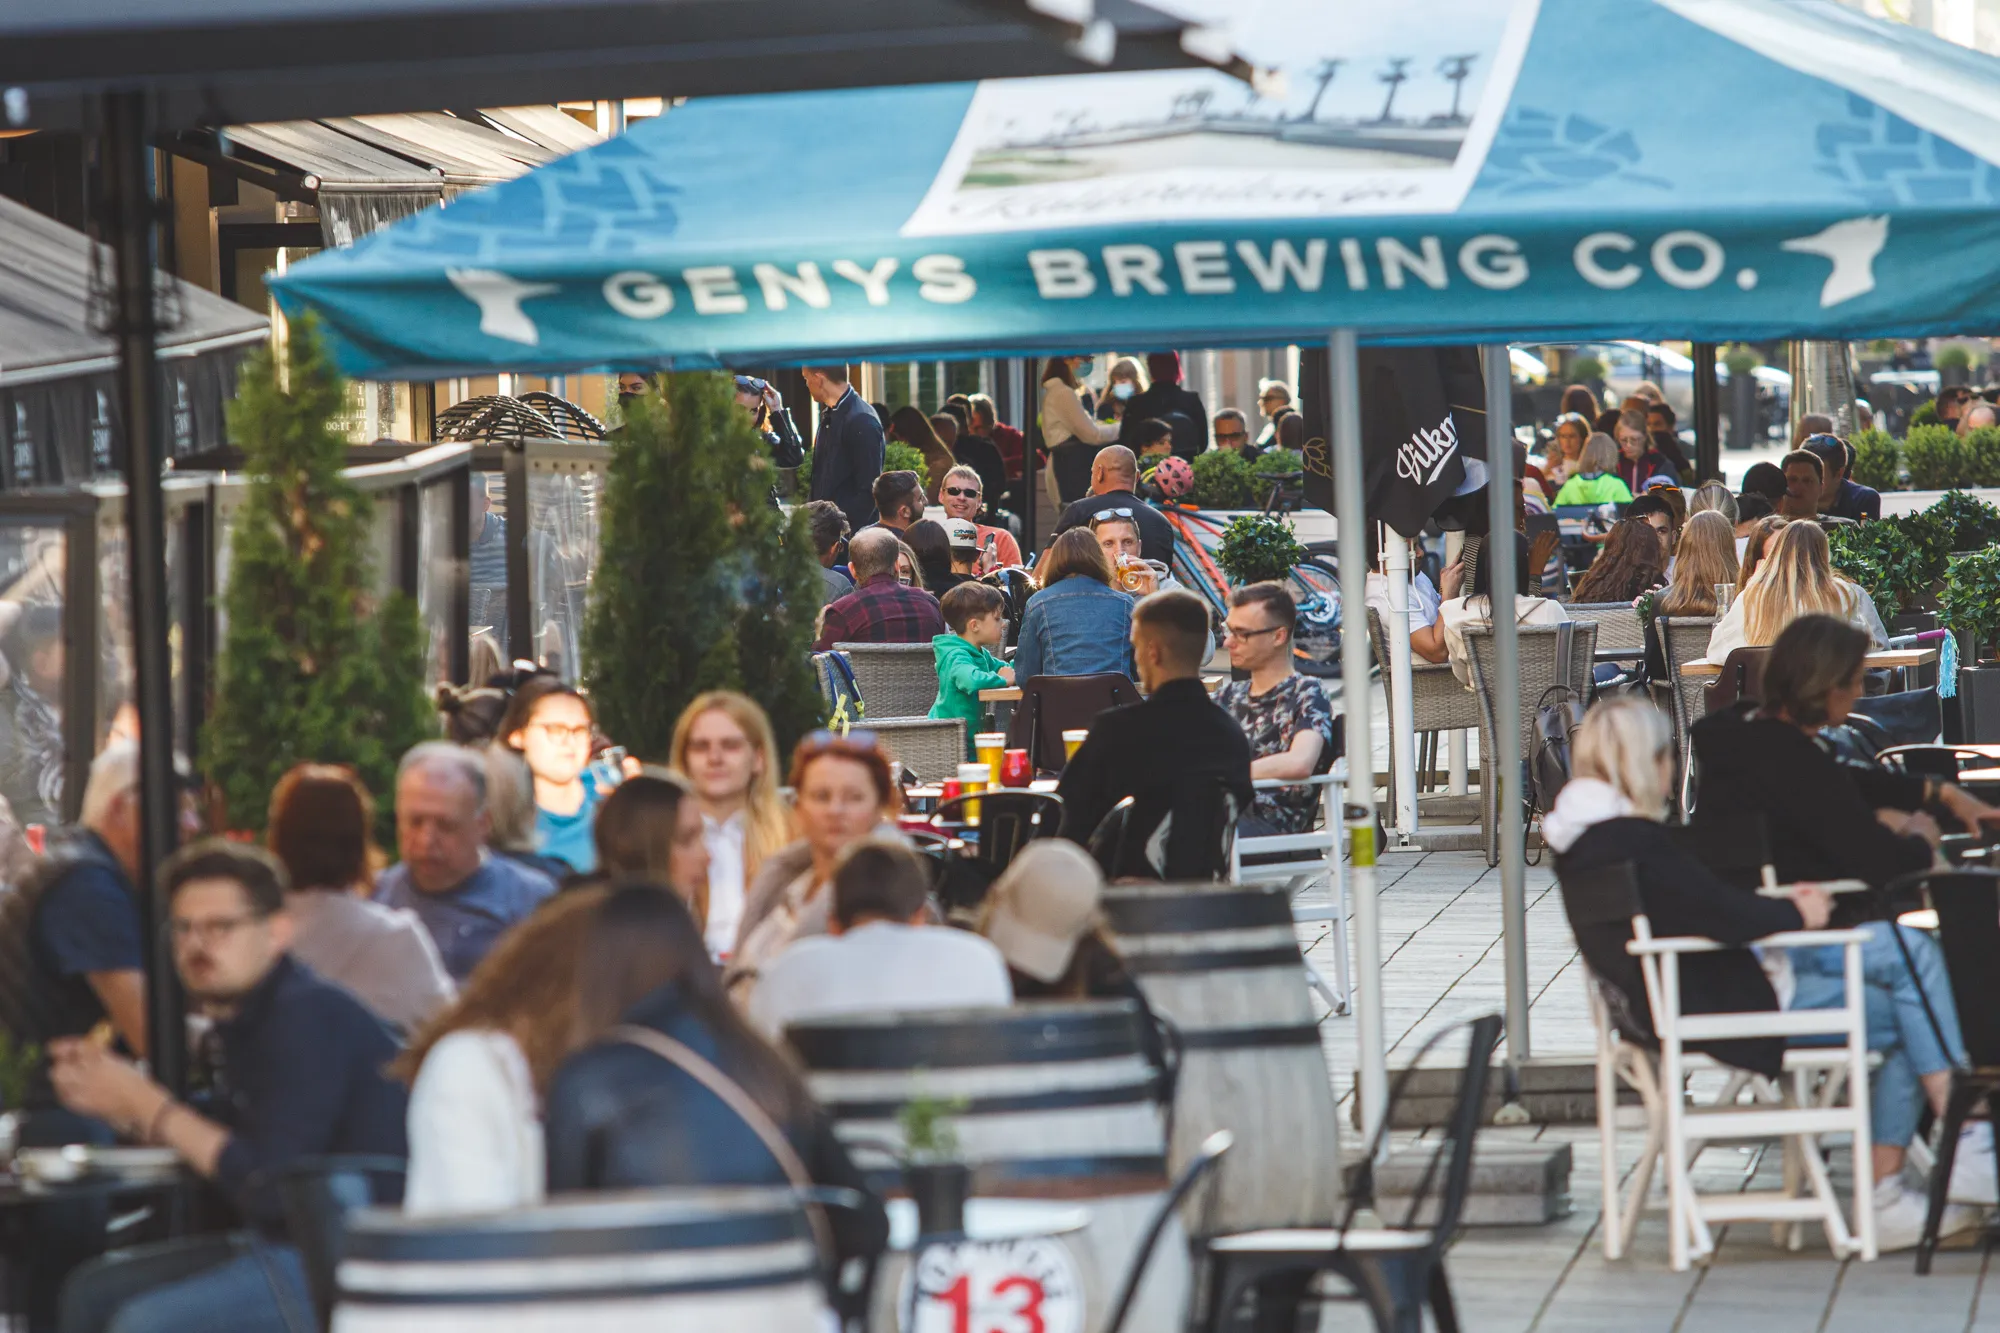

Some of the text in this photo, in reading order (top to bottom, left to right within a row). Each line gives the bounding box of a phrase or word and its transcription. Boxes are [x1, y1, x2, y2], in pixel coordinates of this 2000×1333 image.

[603, 230, 1758, 319] GENYS BREWING CO.
[931, 1273, 1046, 1333] 13
